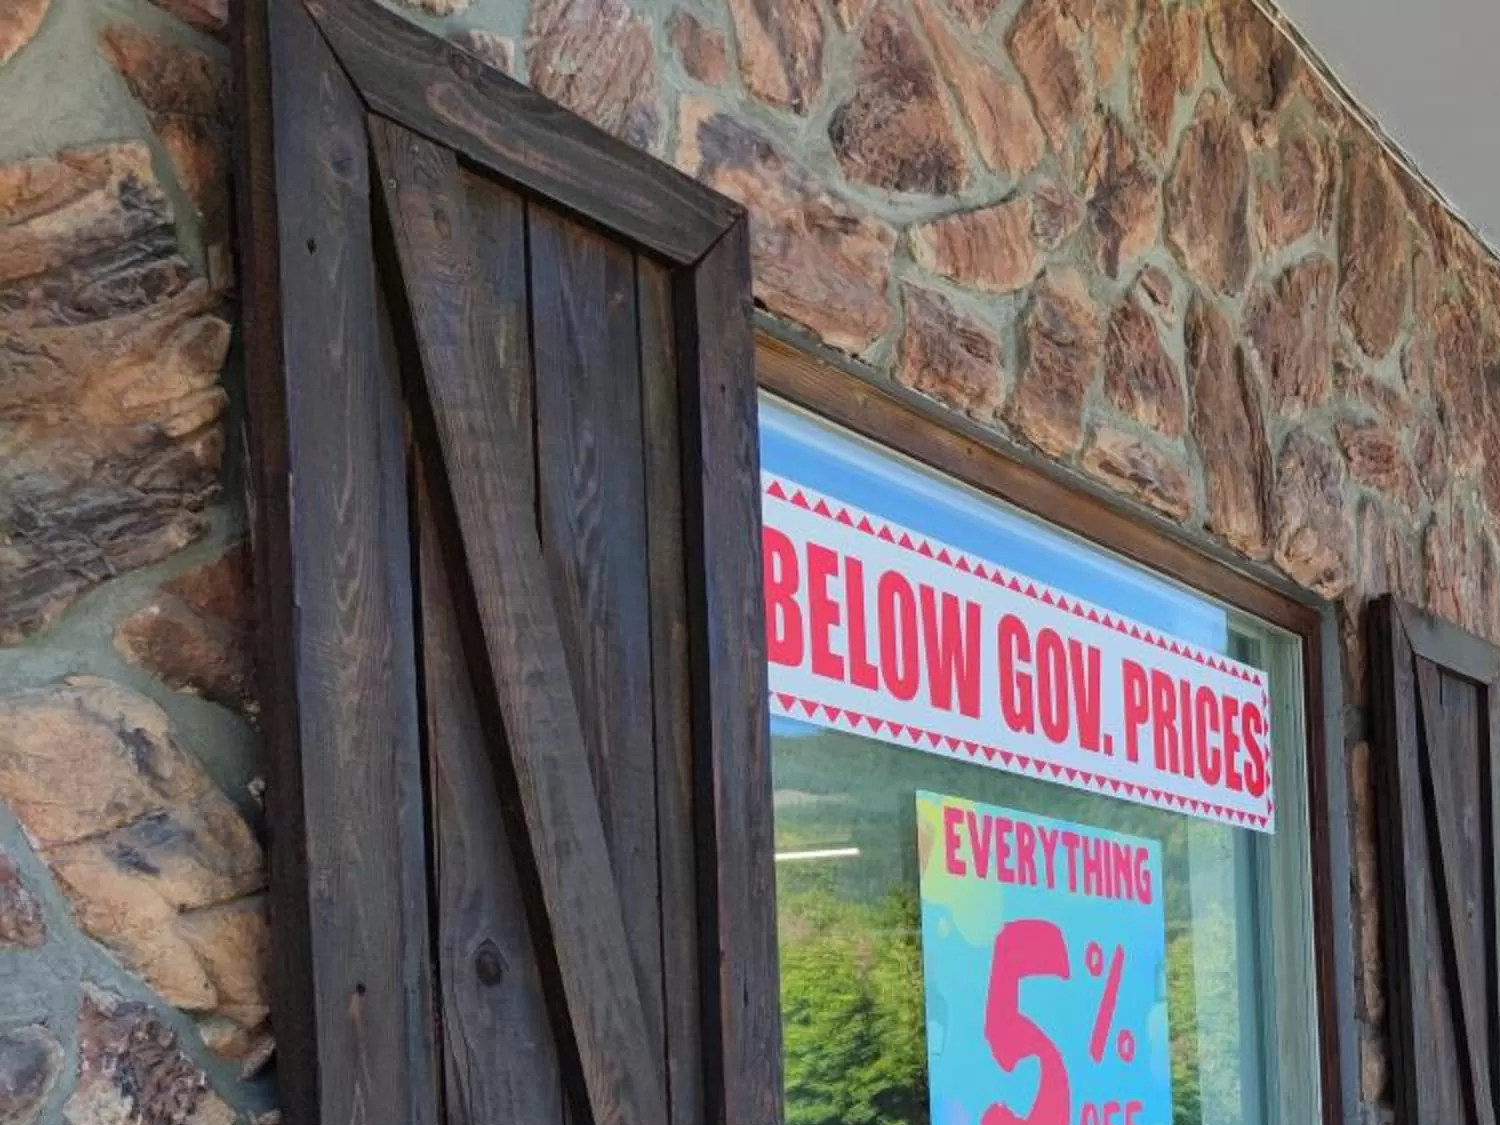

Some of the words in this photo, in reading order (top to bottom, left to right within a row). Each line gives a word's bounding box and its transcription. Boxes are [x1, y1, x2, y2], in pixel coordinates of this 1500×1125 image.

[762, 525, 981, 720] BELOW
[998, 613, 1113, 756] GOV.
[1122, 657, 1265, 798] PRICES
[943, 808, 1153, 904] EVERYTHING
